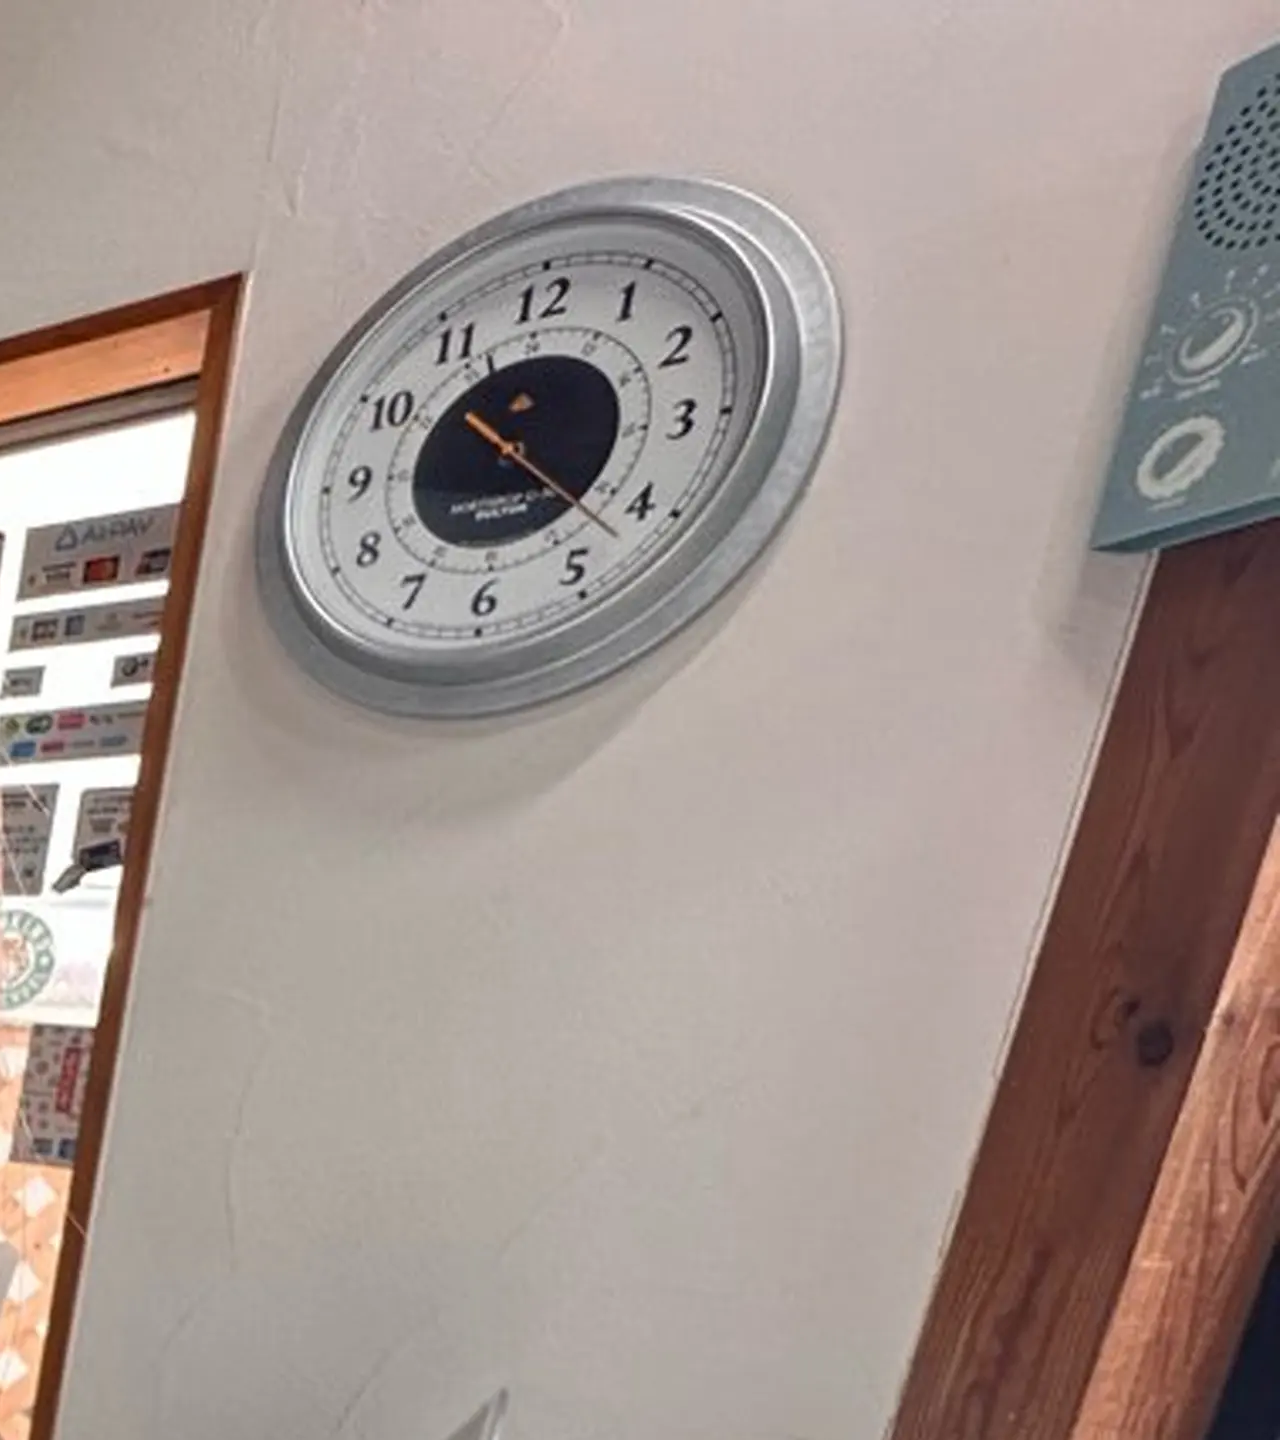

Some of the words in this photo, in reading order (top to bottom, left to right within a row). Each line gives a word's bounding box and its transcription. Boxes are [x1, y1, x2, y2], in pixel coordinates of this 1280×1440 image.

[515, 277, 571, 324] 12
[616, 281, 636, 322] 1
[434, 322, 476, 365] 11
[658, 325, 693, 368] 2
[368, 391, 414, 432] 10
[666, 399, 697, 440] 3
[348, 465, 373, 500] 9
[625, 482, 657, 521] 4
[355, 531, 381, 568] 8
[559, 547, 590, 587] 5
[400, 573, 427, 611] 7
[471, 578, 498, 617] 6
